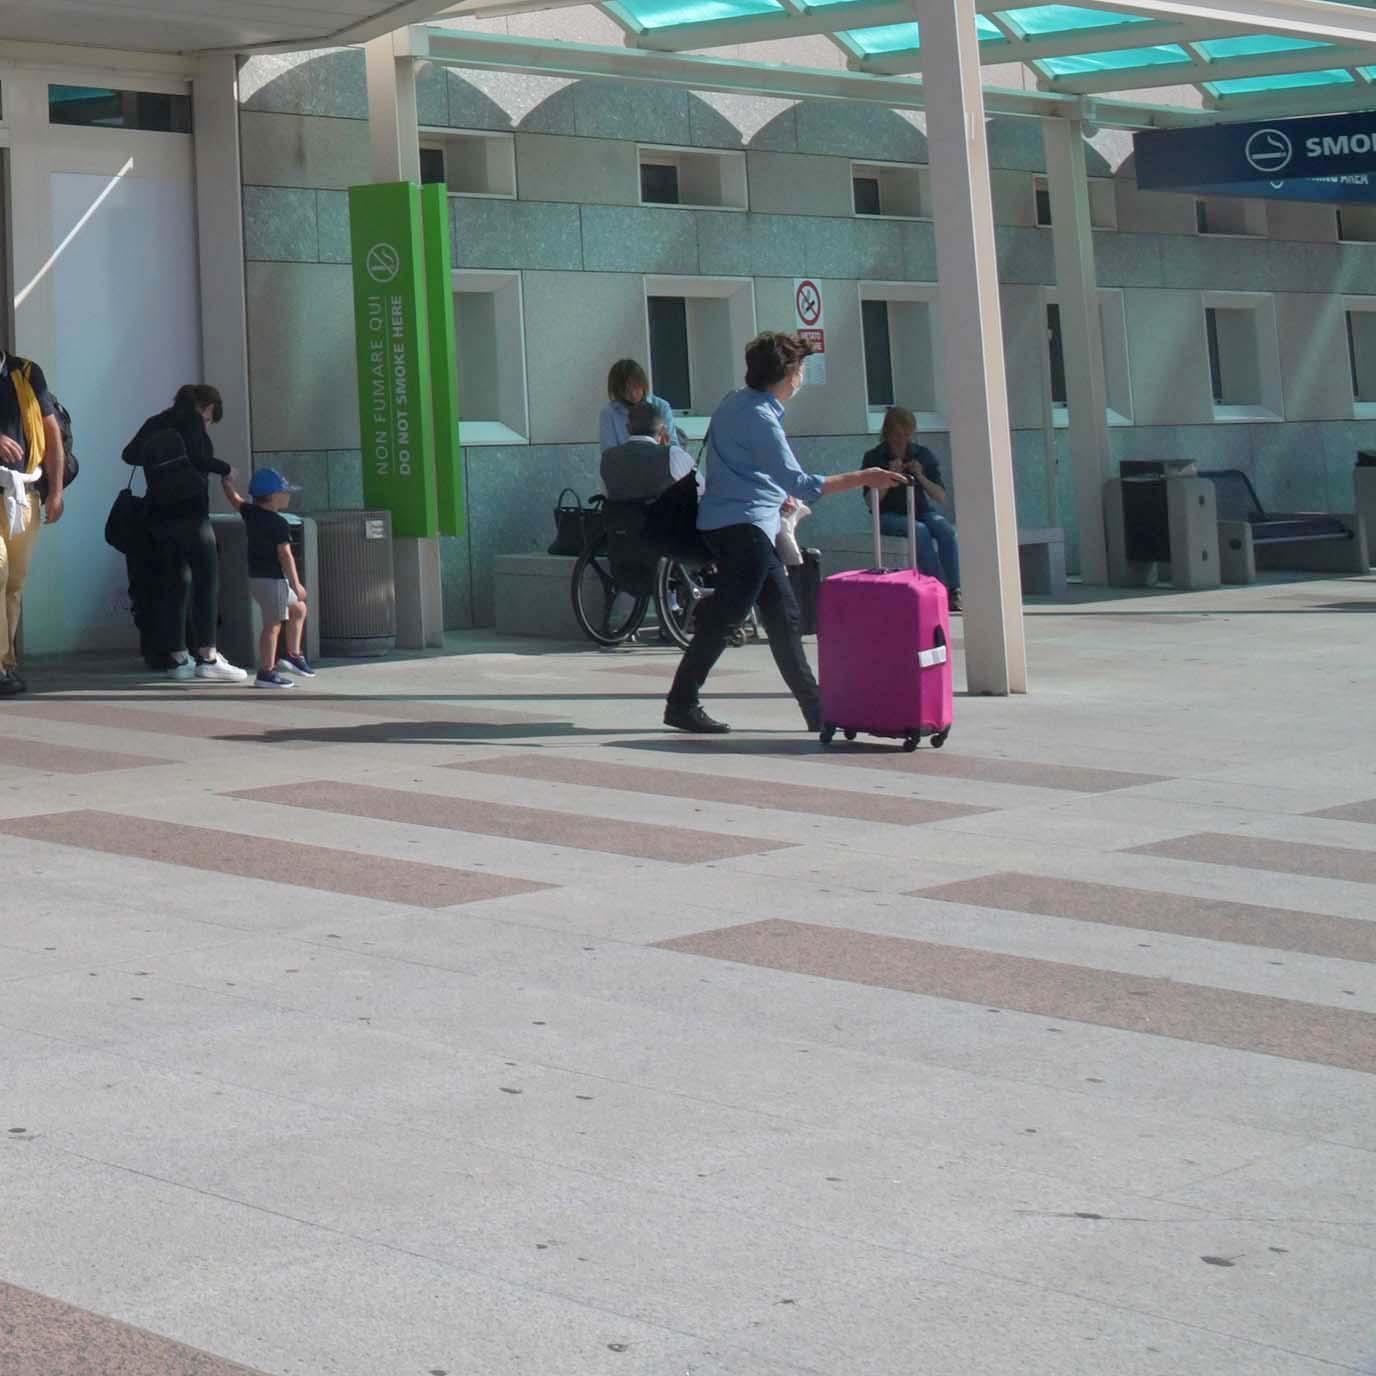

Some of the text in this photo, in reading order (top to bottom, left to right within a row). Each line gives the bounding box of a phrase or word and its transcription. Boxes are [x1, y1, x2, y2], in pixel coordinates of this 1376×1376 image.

[1305, 133, 1376, 157] SMO
[368, 296, 390, 475] NON FUMARE QUI
[391, 295, 412, 475] DO NOT SMOKE HERE
